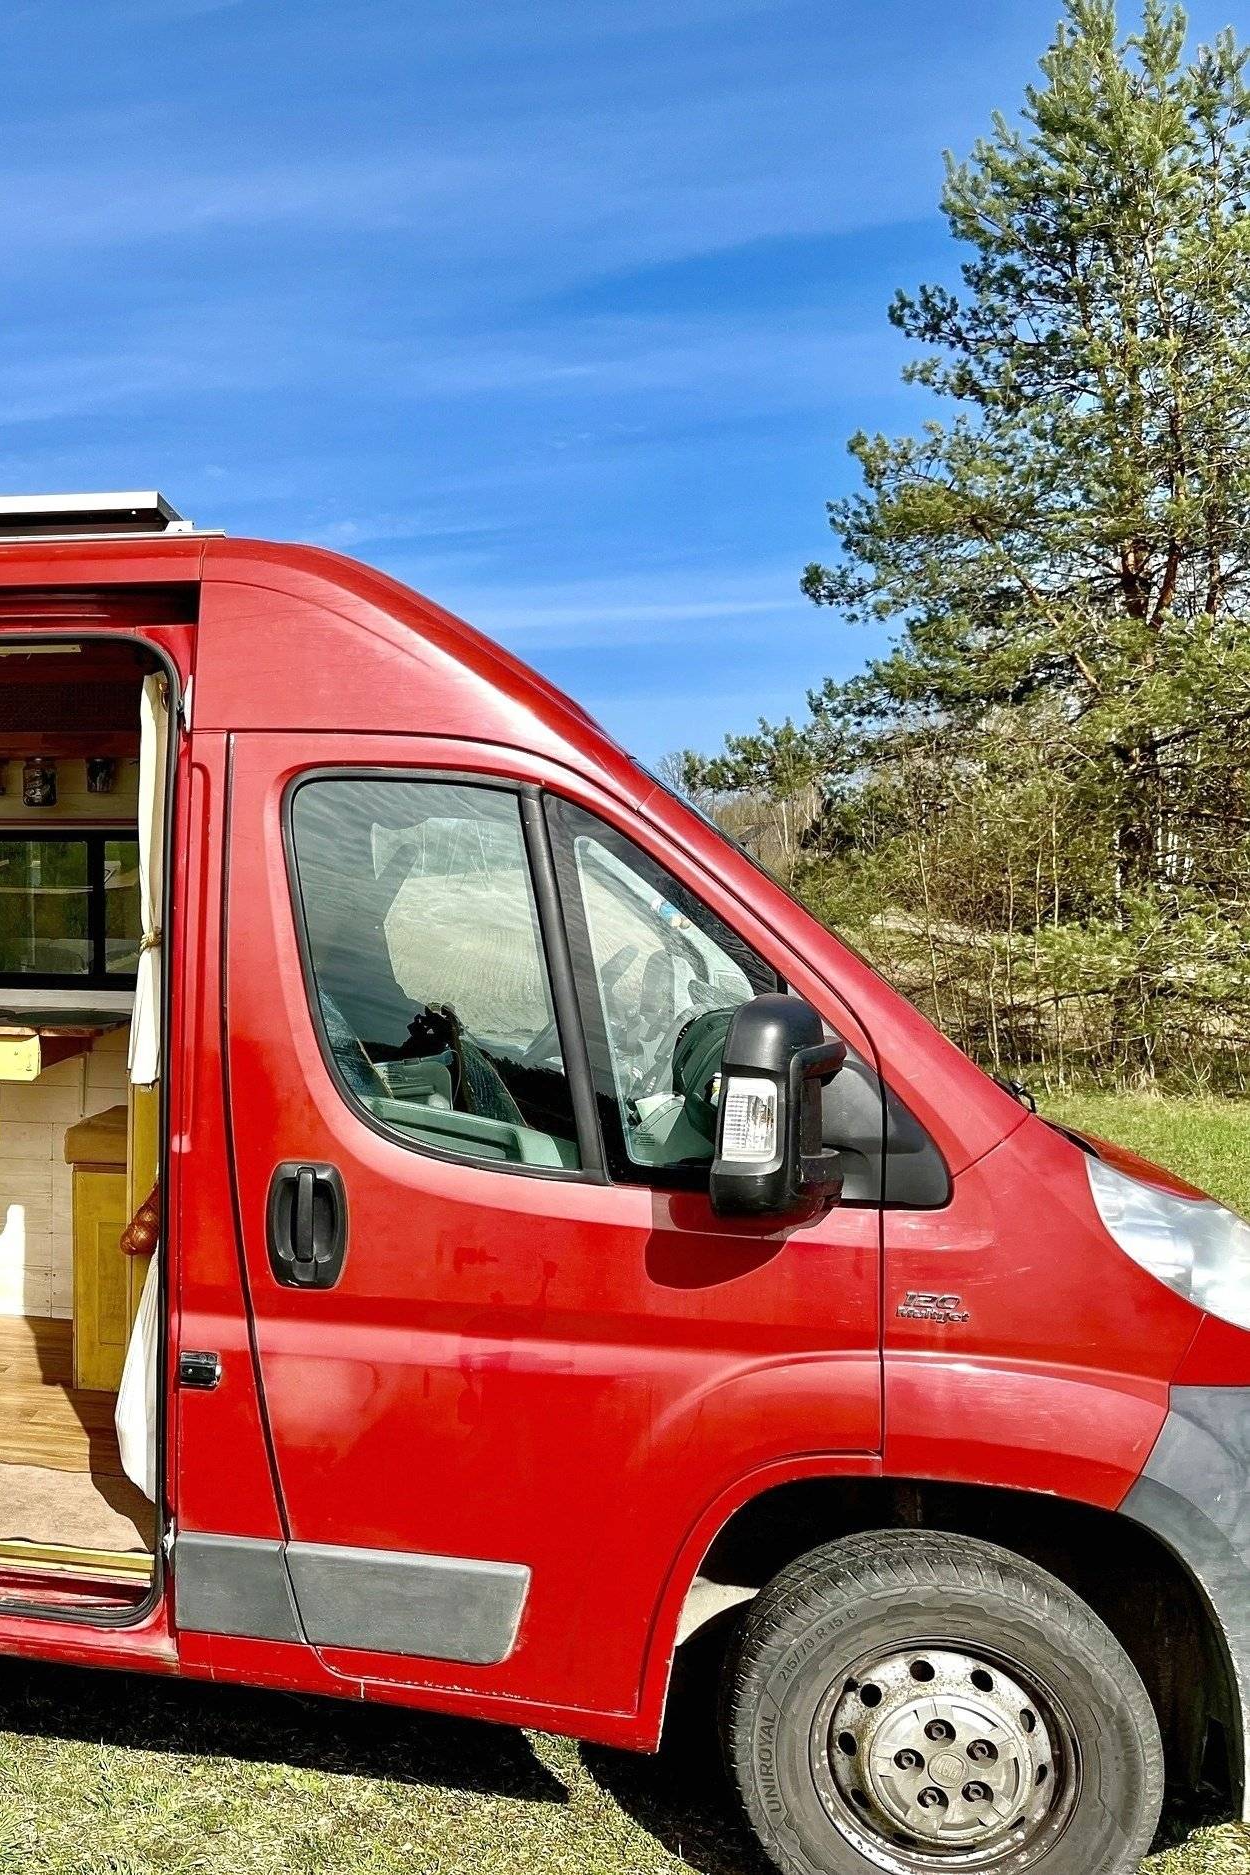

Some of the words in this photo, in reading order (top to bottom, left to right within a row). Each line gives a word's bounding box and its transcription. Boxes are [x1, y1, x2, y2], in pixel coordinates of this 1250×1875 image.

[903, 1291, 961, 1309] 120
[778, 1637, 815, 1682] 215/70
[816, 1627, 829, 1640] R
[758, 1712, 782, 1813] UNIROYAL
